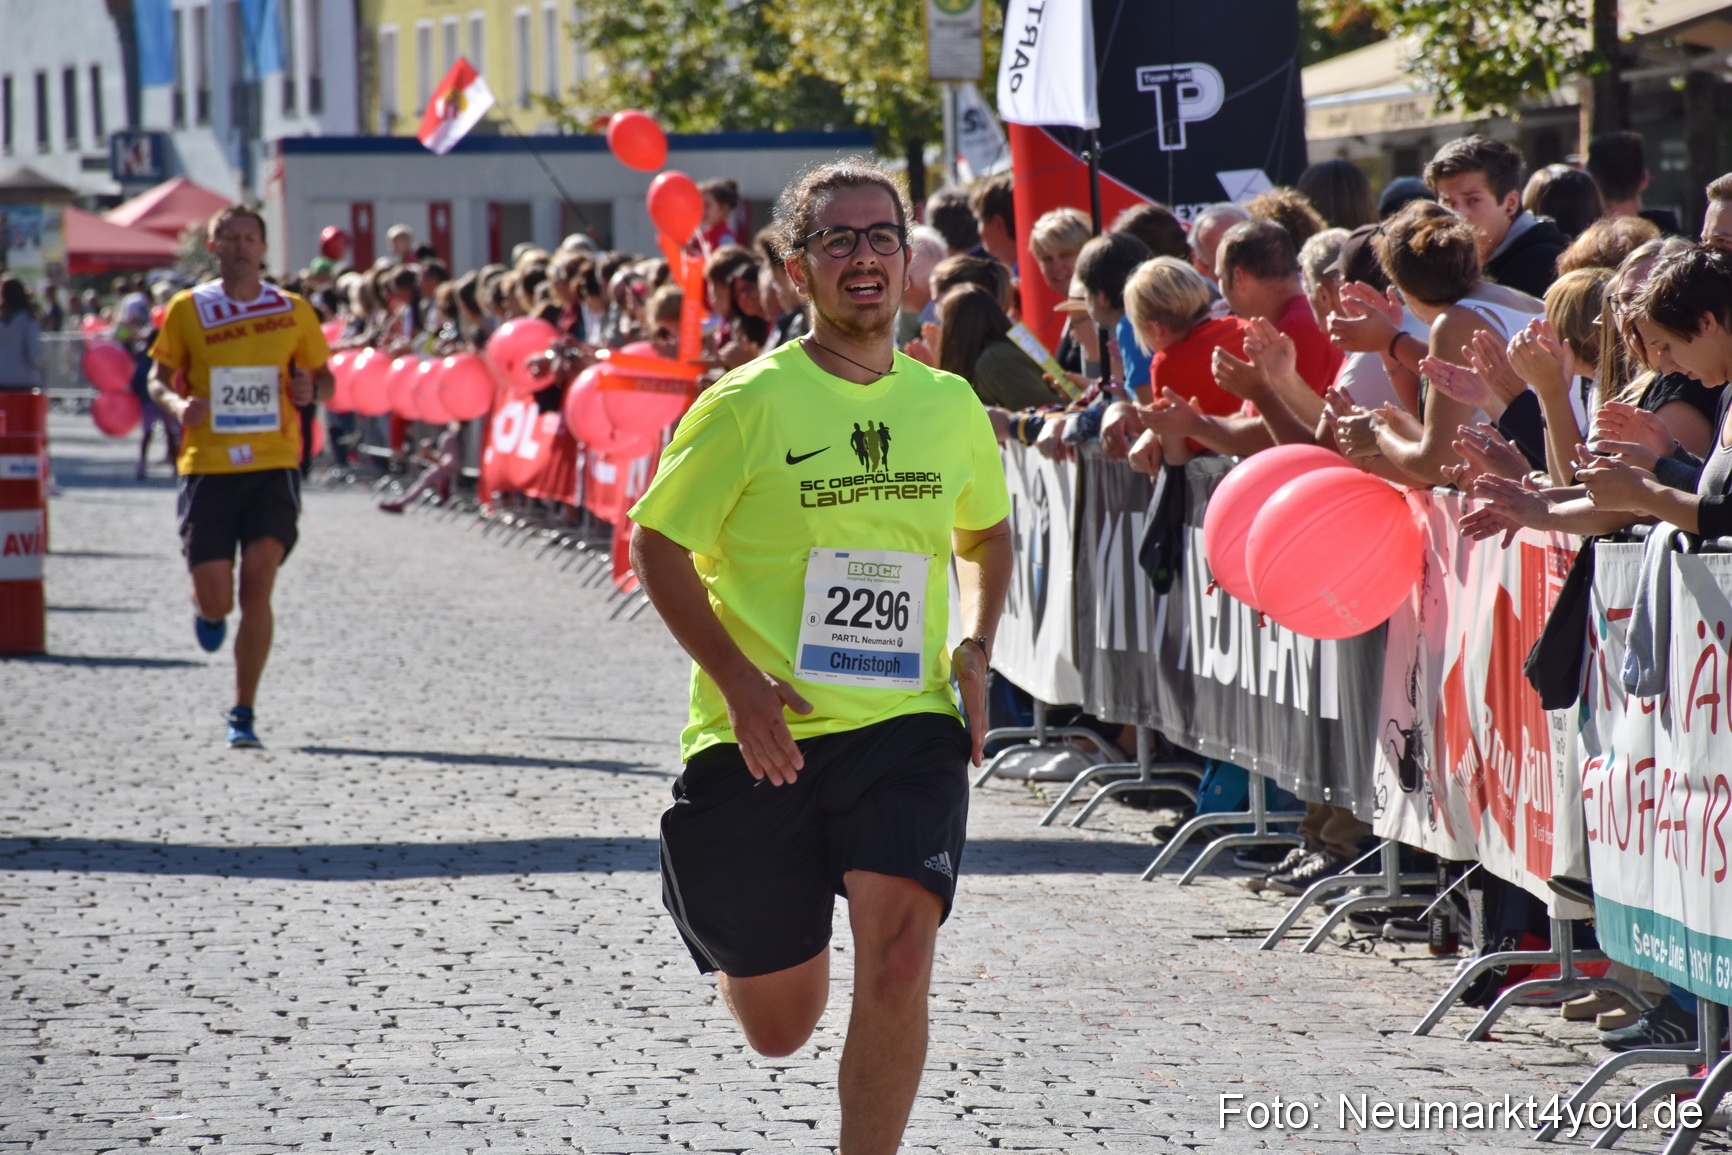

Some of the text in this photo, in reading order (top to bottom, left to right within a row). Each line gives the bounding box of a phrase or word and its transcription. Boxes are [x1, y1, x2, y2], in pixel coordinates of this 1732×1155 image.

[205, 317, 297, 346] MAX BÖGL
[222, 385, 271, 406] 2406
[800, 470, 941, 491] SC OBERÖLSBACH
[800, 484, 943, 508] LAUFTREFF
[847, 562, 902, 578] BOCK
[824, 586, 911, 631] 2296
[831, 633, 896, 646] PARTL Neumarkt
[829, 651, 900, 676] Christoph
